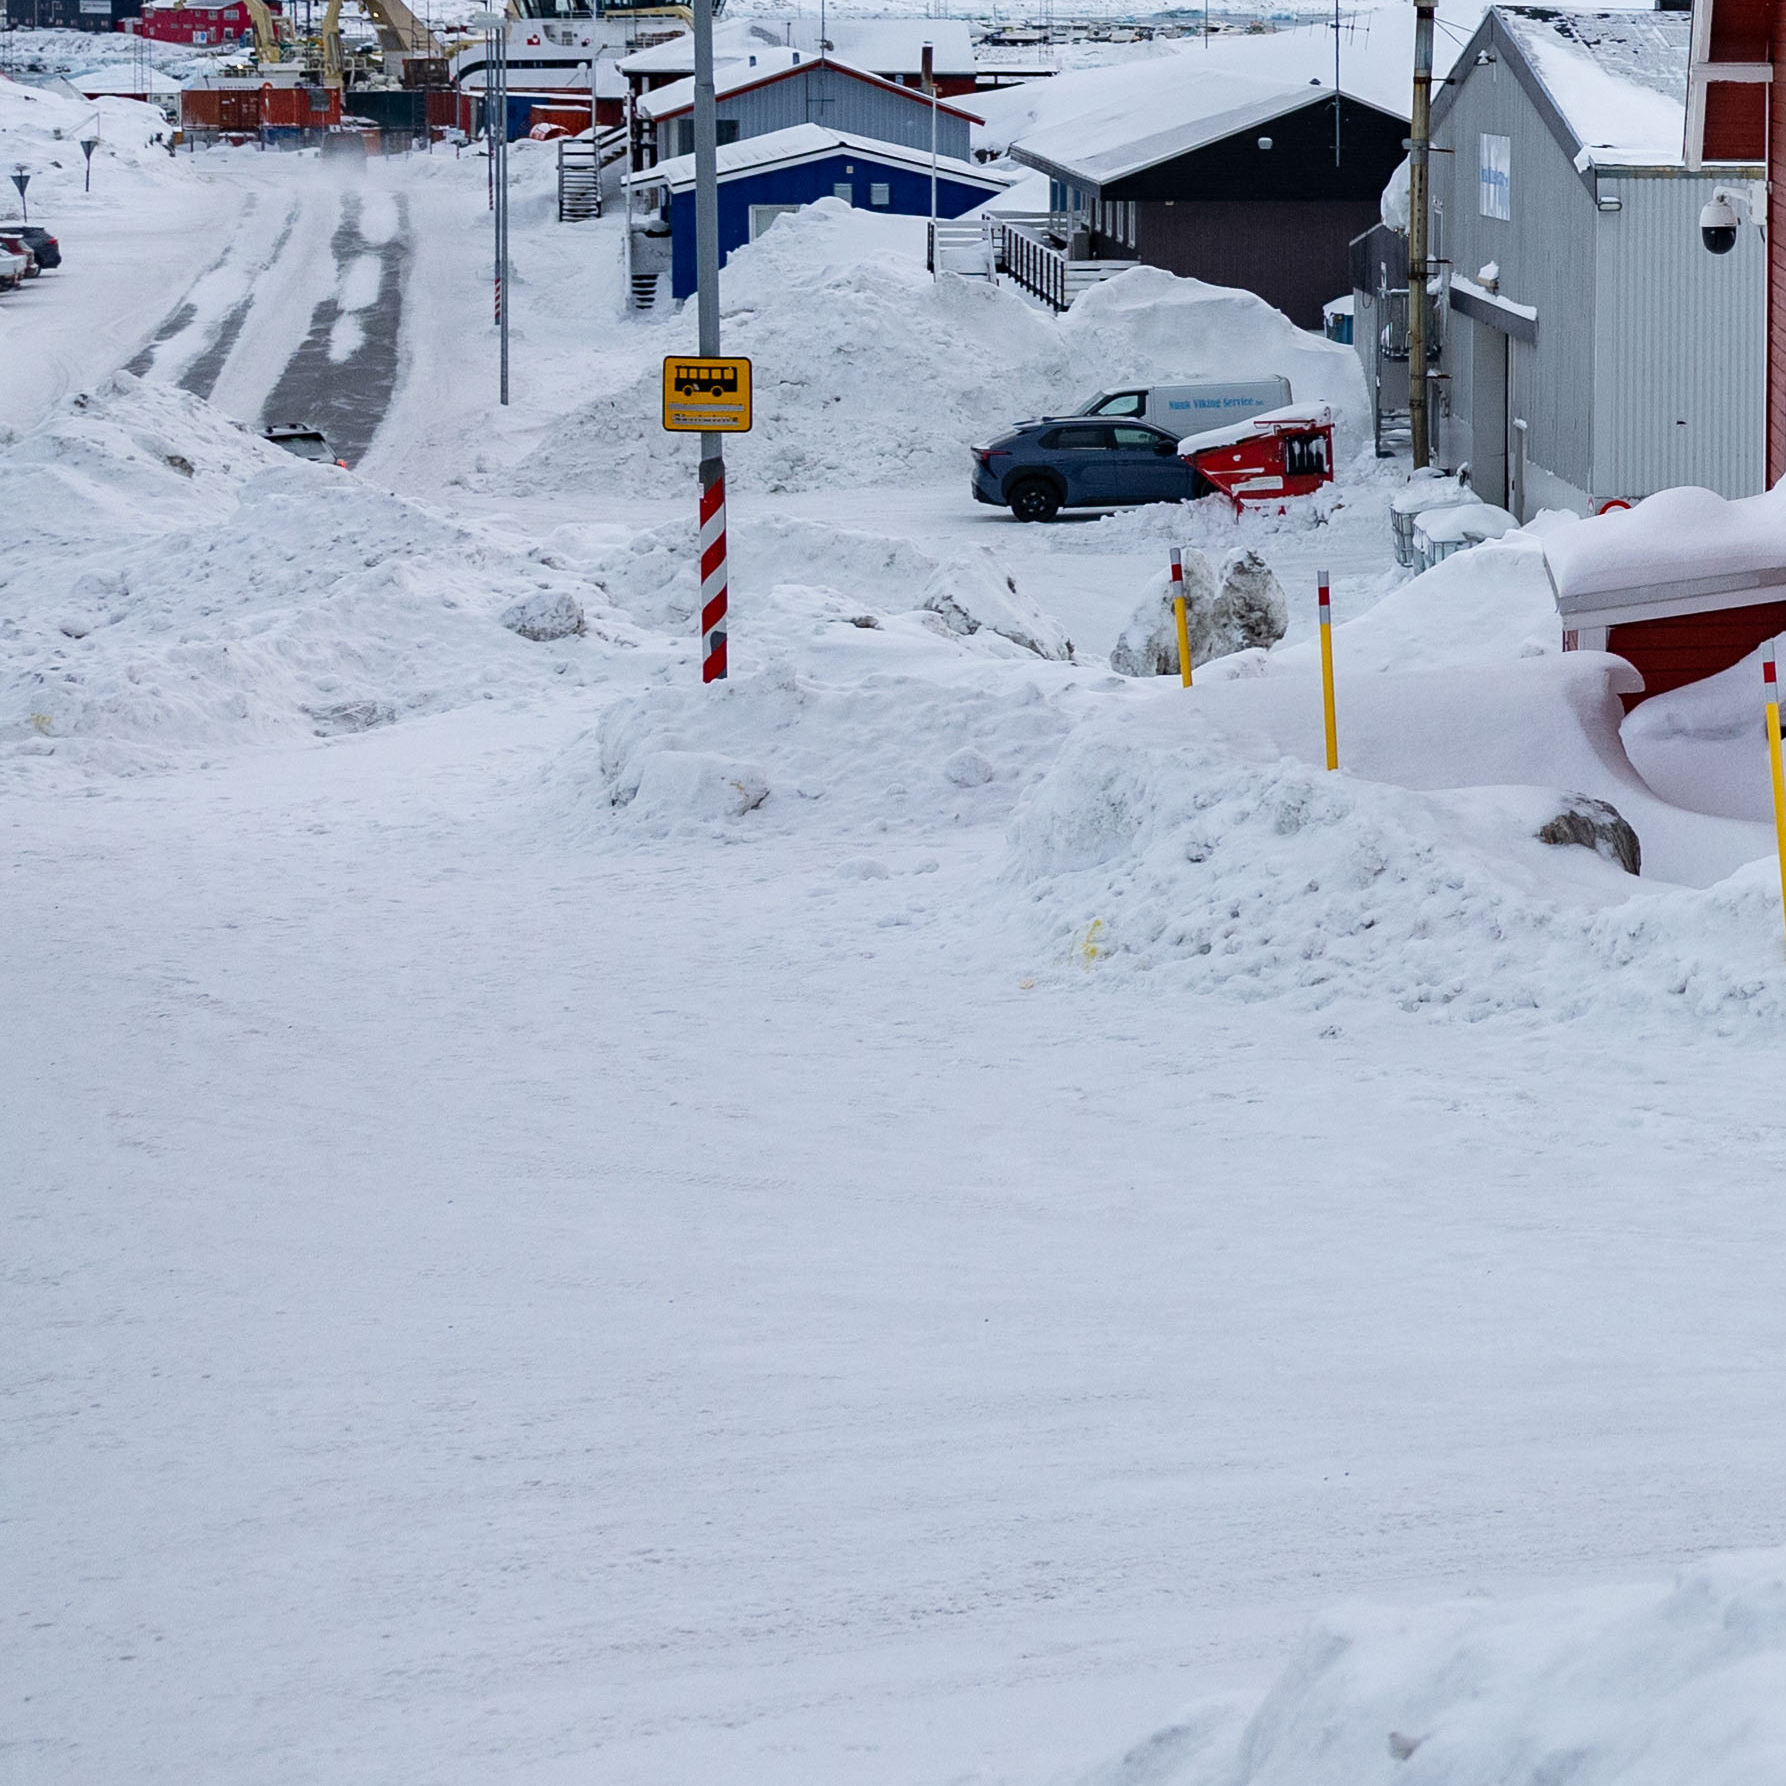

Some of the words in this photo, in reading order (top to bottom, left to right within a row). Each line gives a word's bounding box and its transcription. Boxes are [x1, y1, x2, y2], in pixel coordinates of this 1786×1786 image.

[1168, 400, 1191, 410] Nuuk
[1193, 398, 1221, 409] Viking
[1223, 397, 1254, 407] Service
